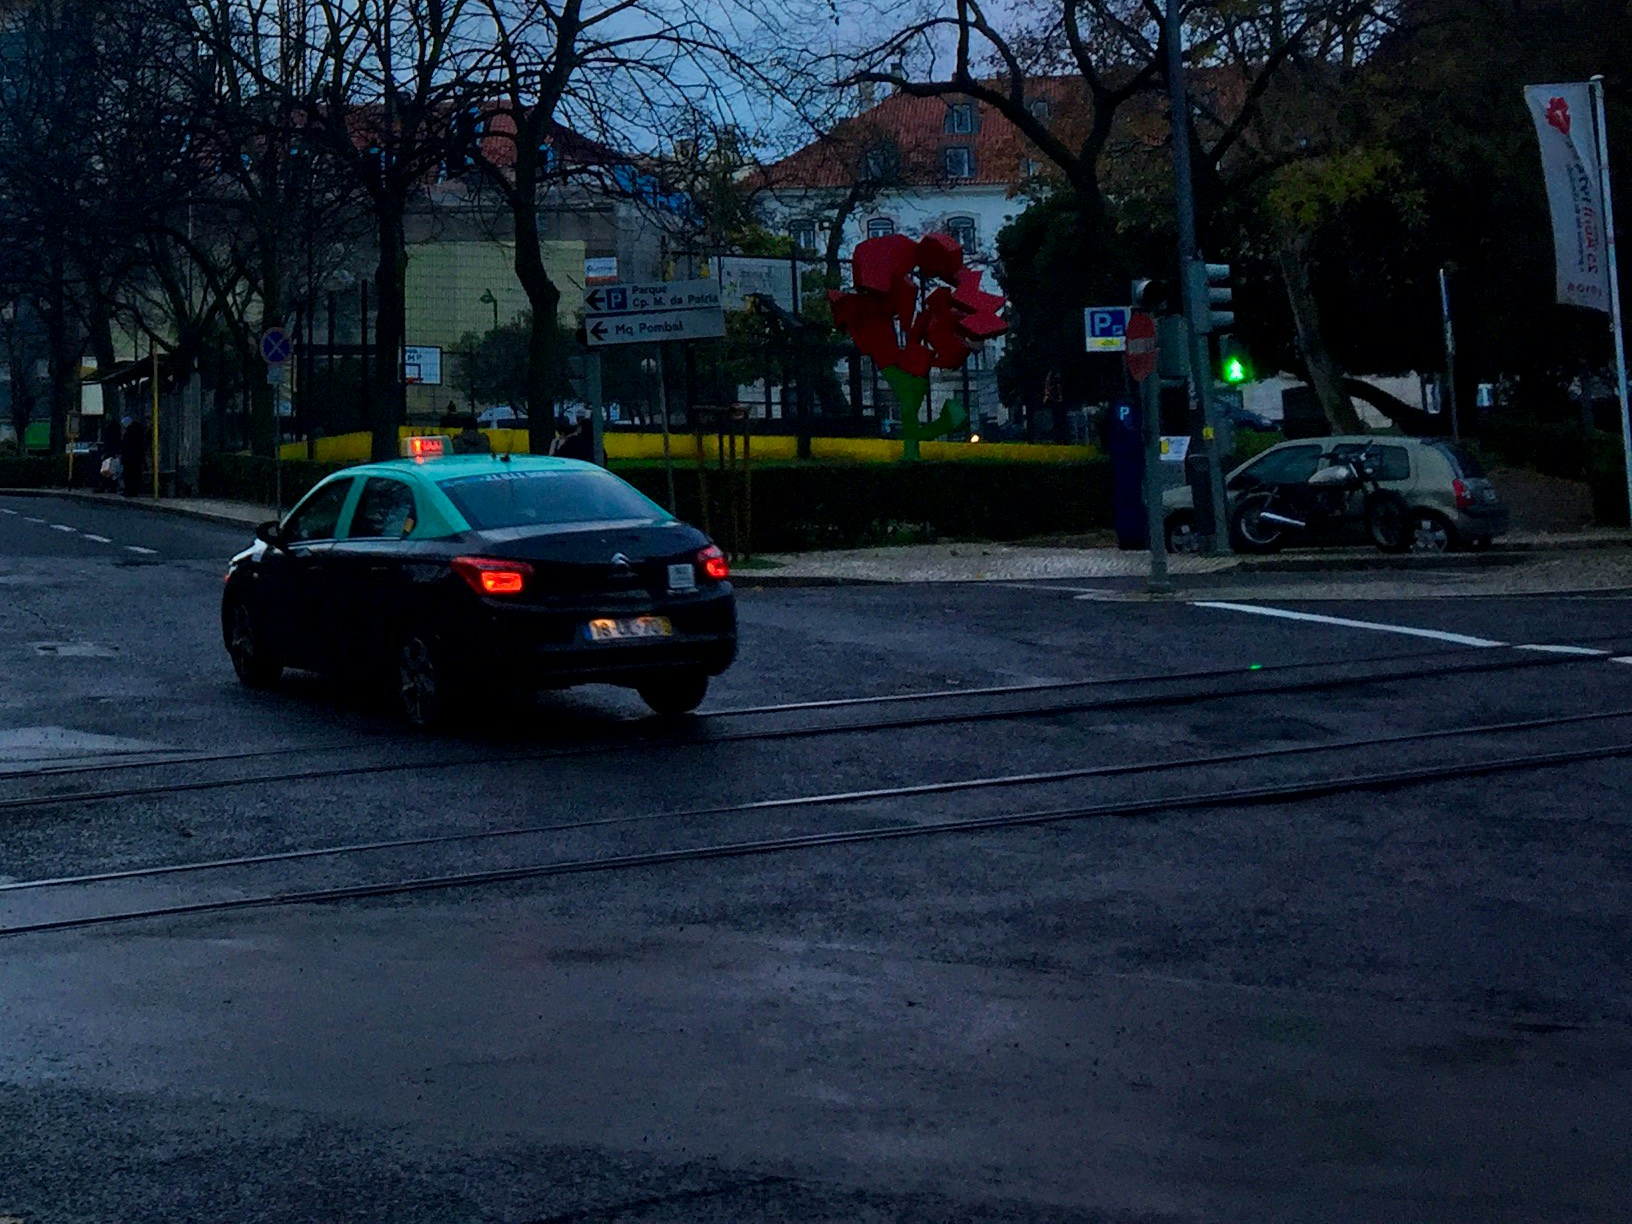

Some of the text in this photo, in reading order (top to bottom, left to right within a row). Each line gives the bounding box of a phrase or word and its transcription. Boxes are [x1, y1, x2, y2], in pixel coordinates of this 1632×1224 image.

[631, 285, 667, 296] Parque
[610, 291, 622, 308] P
[632, 297, 649, 309] Cp.
[653, 296, 665, 306] M.
[669, 295, 683, 305] da
[615, 320, 684, 337] Mq Pombal
[1093, 312, 1112, 336] P
[1119, 405, 1130, 421] P
